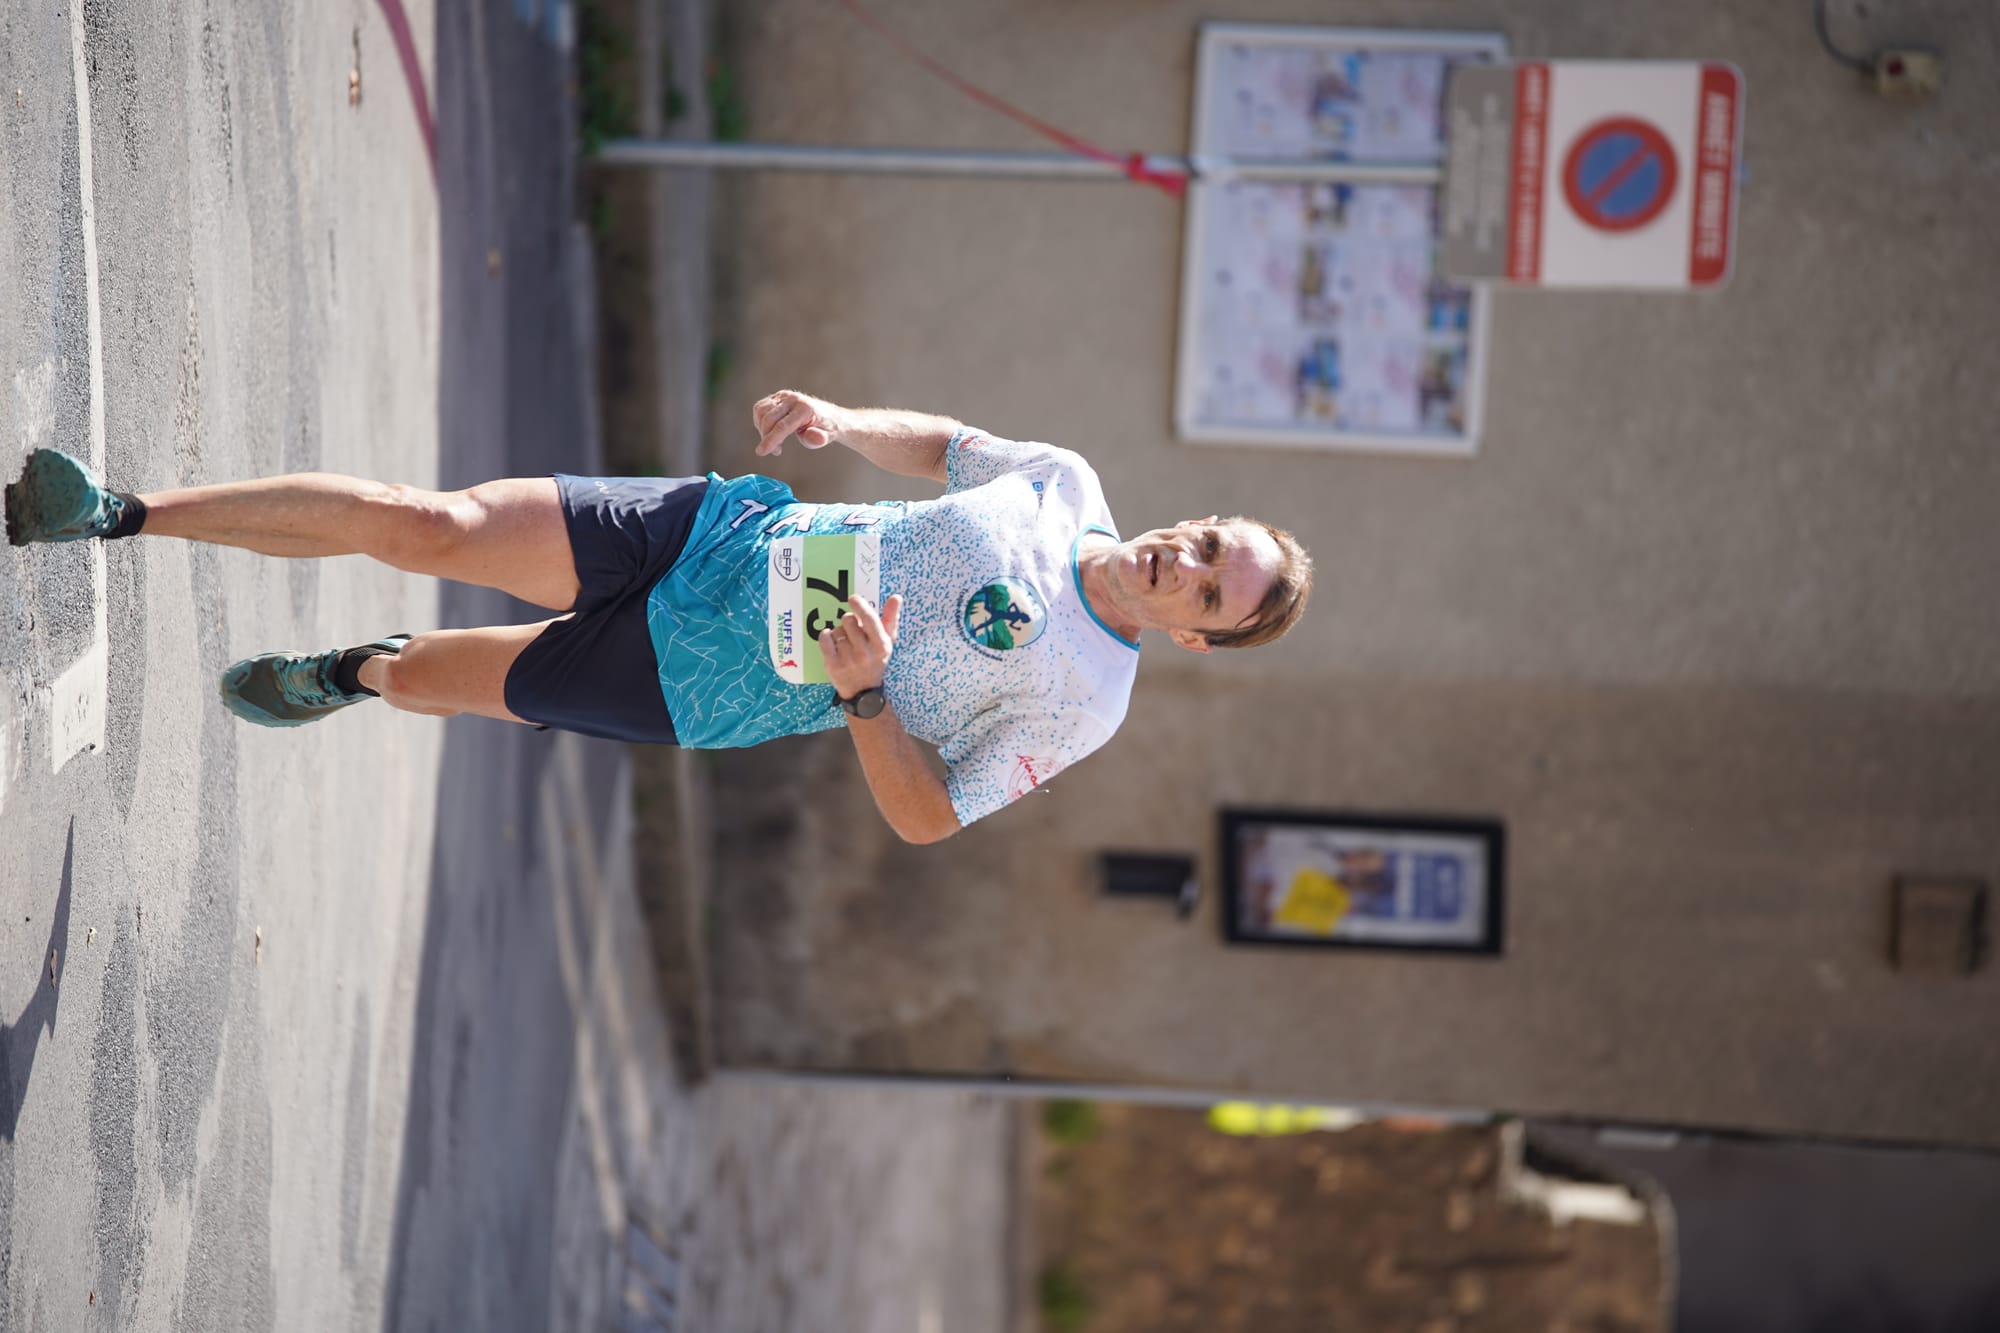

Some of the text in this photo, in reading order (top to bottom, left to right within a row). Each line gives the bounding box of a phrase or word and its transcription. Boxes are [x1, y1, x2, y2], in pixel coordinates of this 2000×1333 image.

[782, 548, 792, 576] BFP
[806, 569, 849, 641] 73
[777, 614, 786, 659] Aventure
[783, 609, 793, 655] TUFF'S
